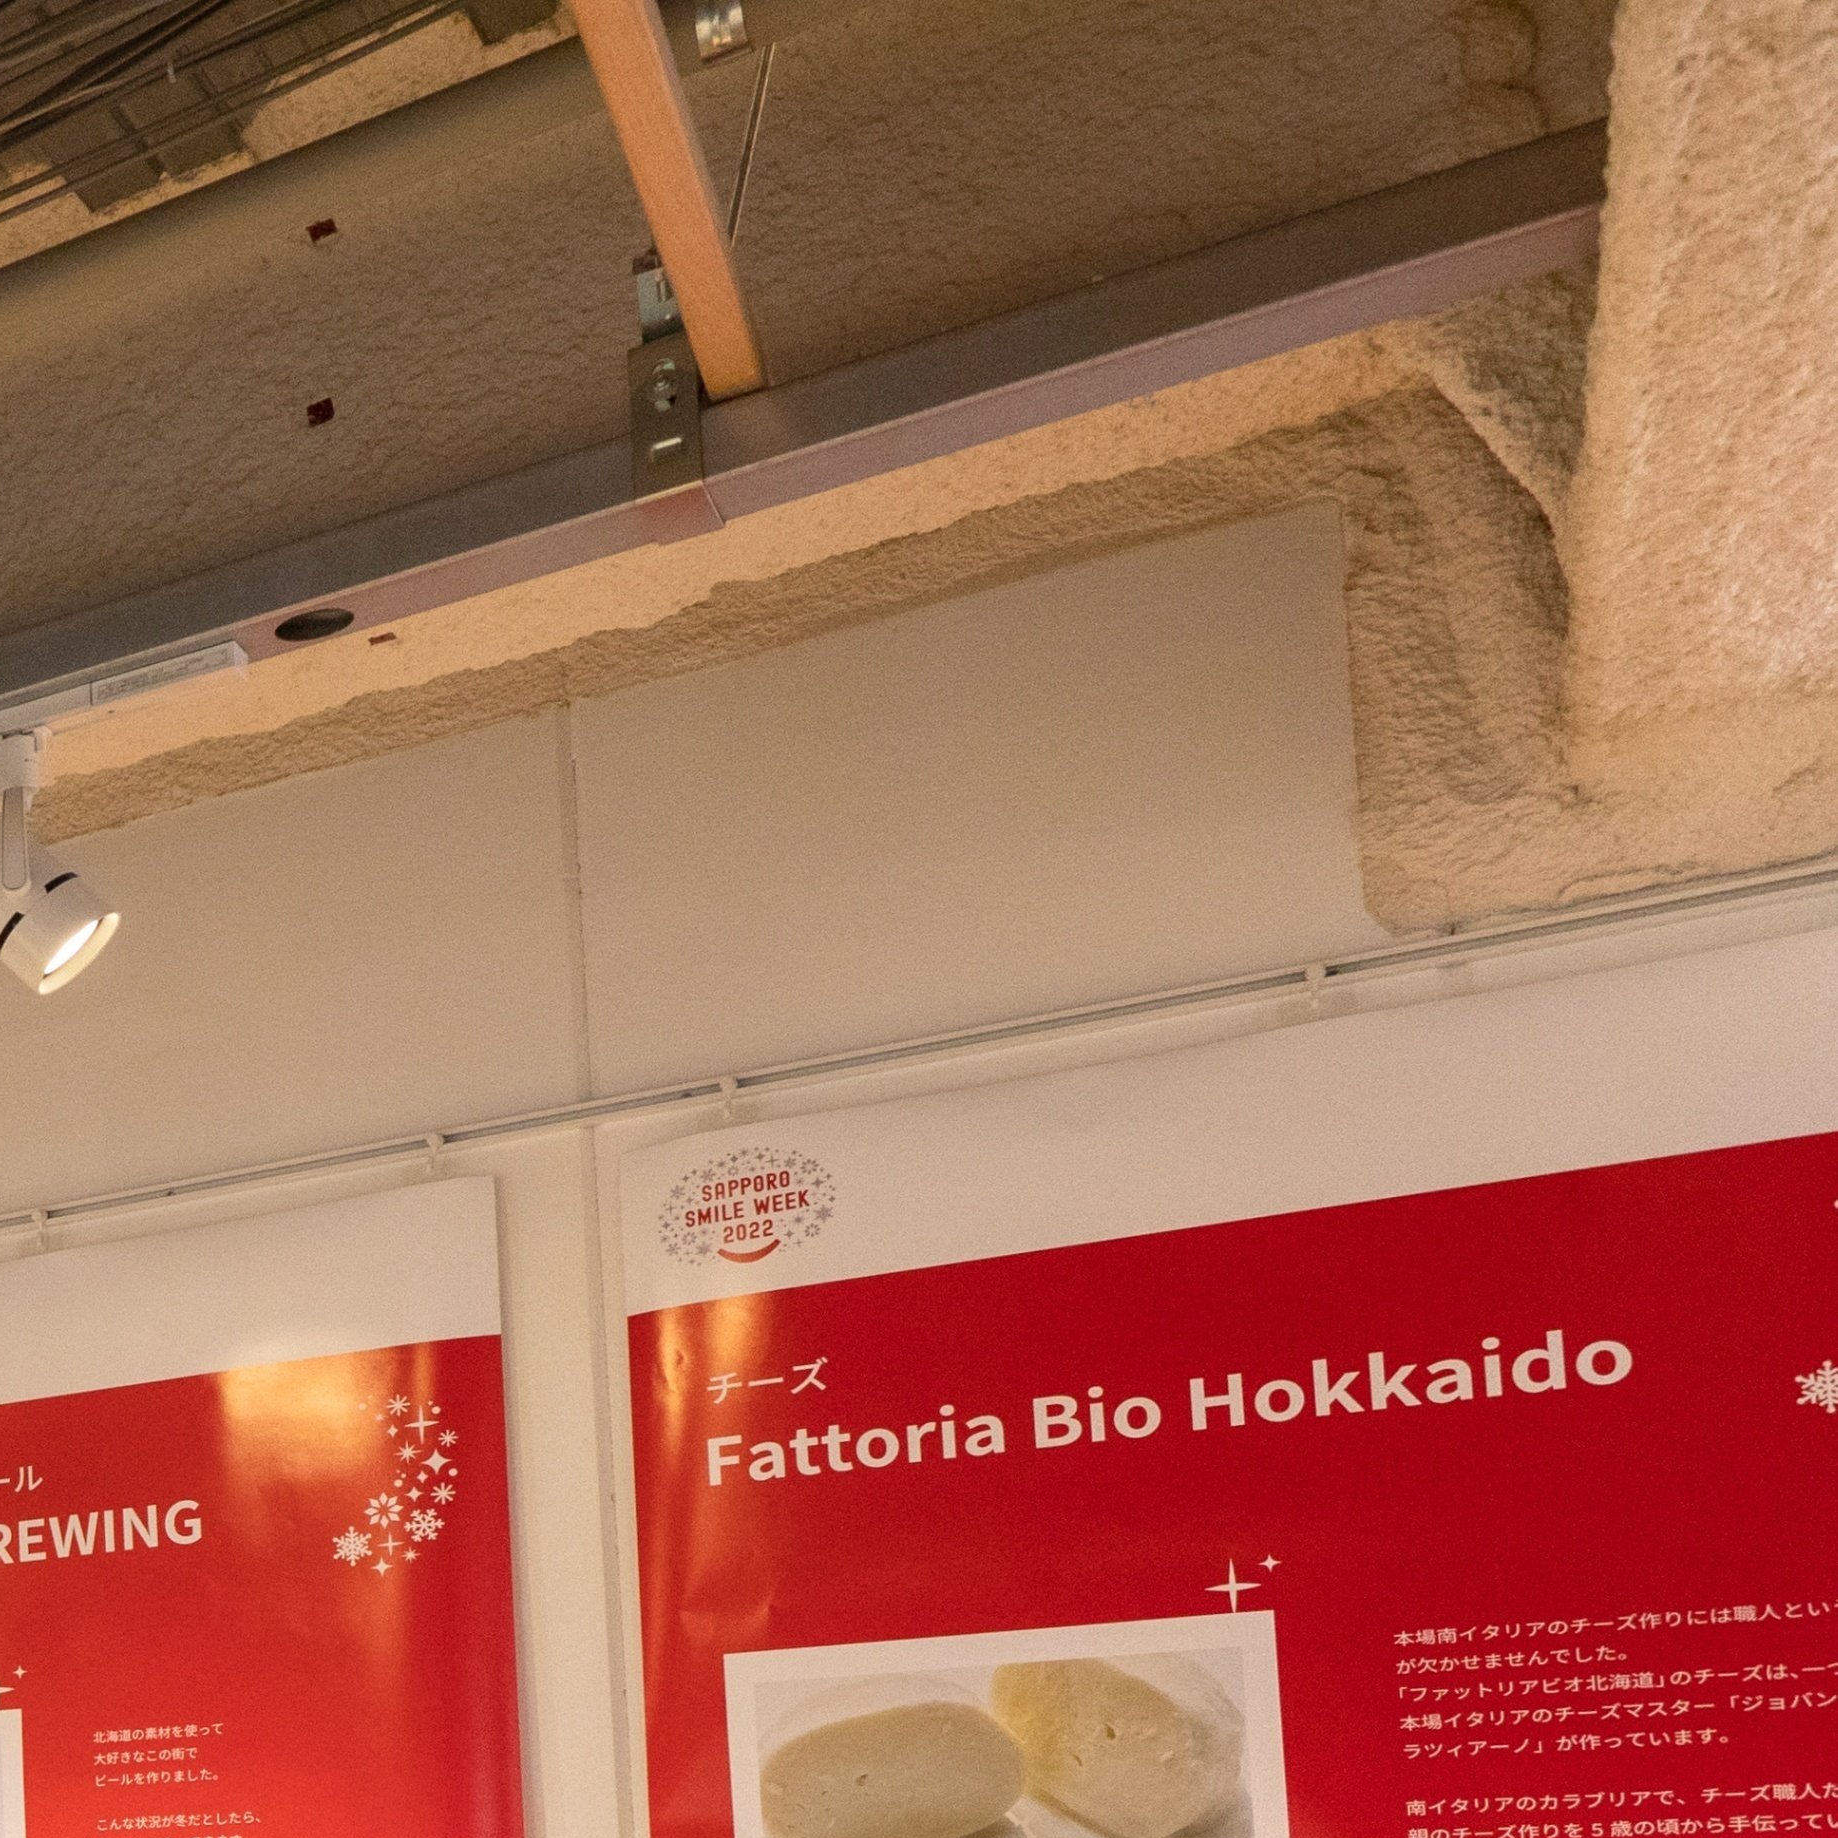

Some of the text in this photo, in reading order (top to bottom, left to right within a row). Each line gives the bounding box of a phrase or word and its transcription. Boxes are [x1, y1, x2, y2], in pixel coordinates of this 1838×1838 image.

[702, 1170, 790, 1202] SAPPORO
[685, 1189, 810, 1227] SMILE WEEK
[723, 1219, 774, 1244] 2022
[707, 1357, 830, 1405] チーズ
[705, 1328, 1636, 1488] Fattoria Bio Hokkaido
[1393, 1599, 1838, 1647] 本場南イタリアのチーズ作りには職人とい
[1396, 1644, 1628, 1674] が欠かせませんでした。
[93, 1722, 224, 1745] 北海道の素材を使って
[94, 1747, 198, 1766] 大好きなこの街で
[95, 1768, 219, 1787] ビールを作りました。
[96, 1811, 262, 1832] こんな状況が冬だとしたら、
